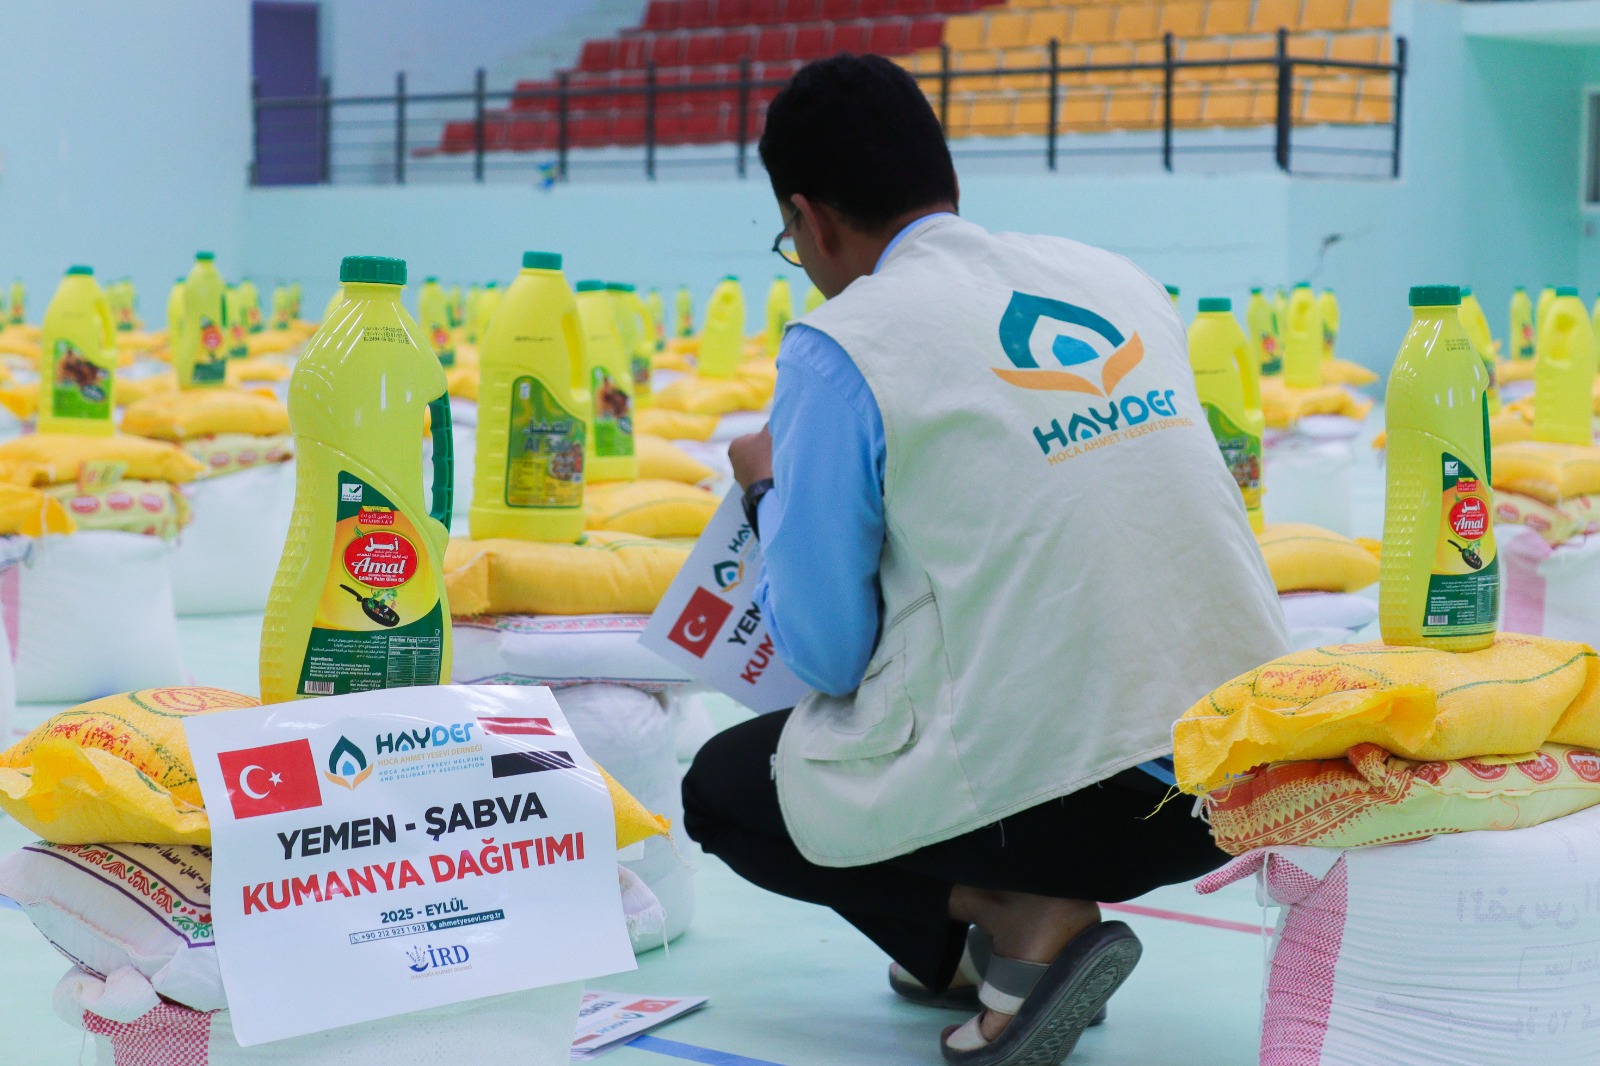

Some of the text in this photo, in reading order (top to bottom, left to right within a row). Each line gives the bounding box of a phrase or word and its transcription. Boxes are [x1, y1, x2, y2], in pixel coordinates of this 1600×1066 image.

[1047, 448, 1082, 466] HOCA
[1084, 432, 1121, 452] AHMET
[1454, 517, 1484, 531] Amal
[351, 557, 406, 574] Amal
[378, 758, 398, 767] HOCA
[400, 754, 426, 764] AHMET
[454, 756, 484, 764] HELPING
[397, 770, 436, 780] SOLIDARITY
[440, 763, 484, 773] ASSOCIATION
[277, 814, 396, 860] YEMEN
[425, 792, 548, 842] ŞABVA
[243, 832, 585, 915] KUMANYA DAĞITIMI
[380, 908, 414, 924] 2025
[425, 898, 468, 916] EYLÜL
[438, 912, 501, 928] ahmetyesevi.org.tr
[361, 932, 376, 940] +90
[391, 928, 405, 936] 923
[412, 924, 426, 932] 923
[427, 944, 470, 968] İRD
